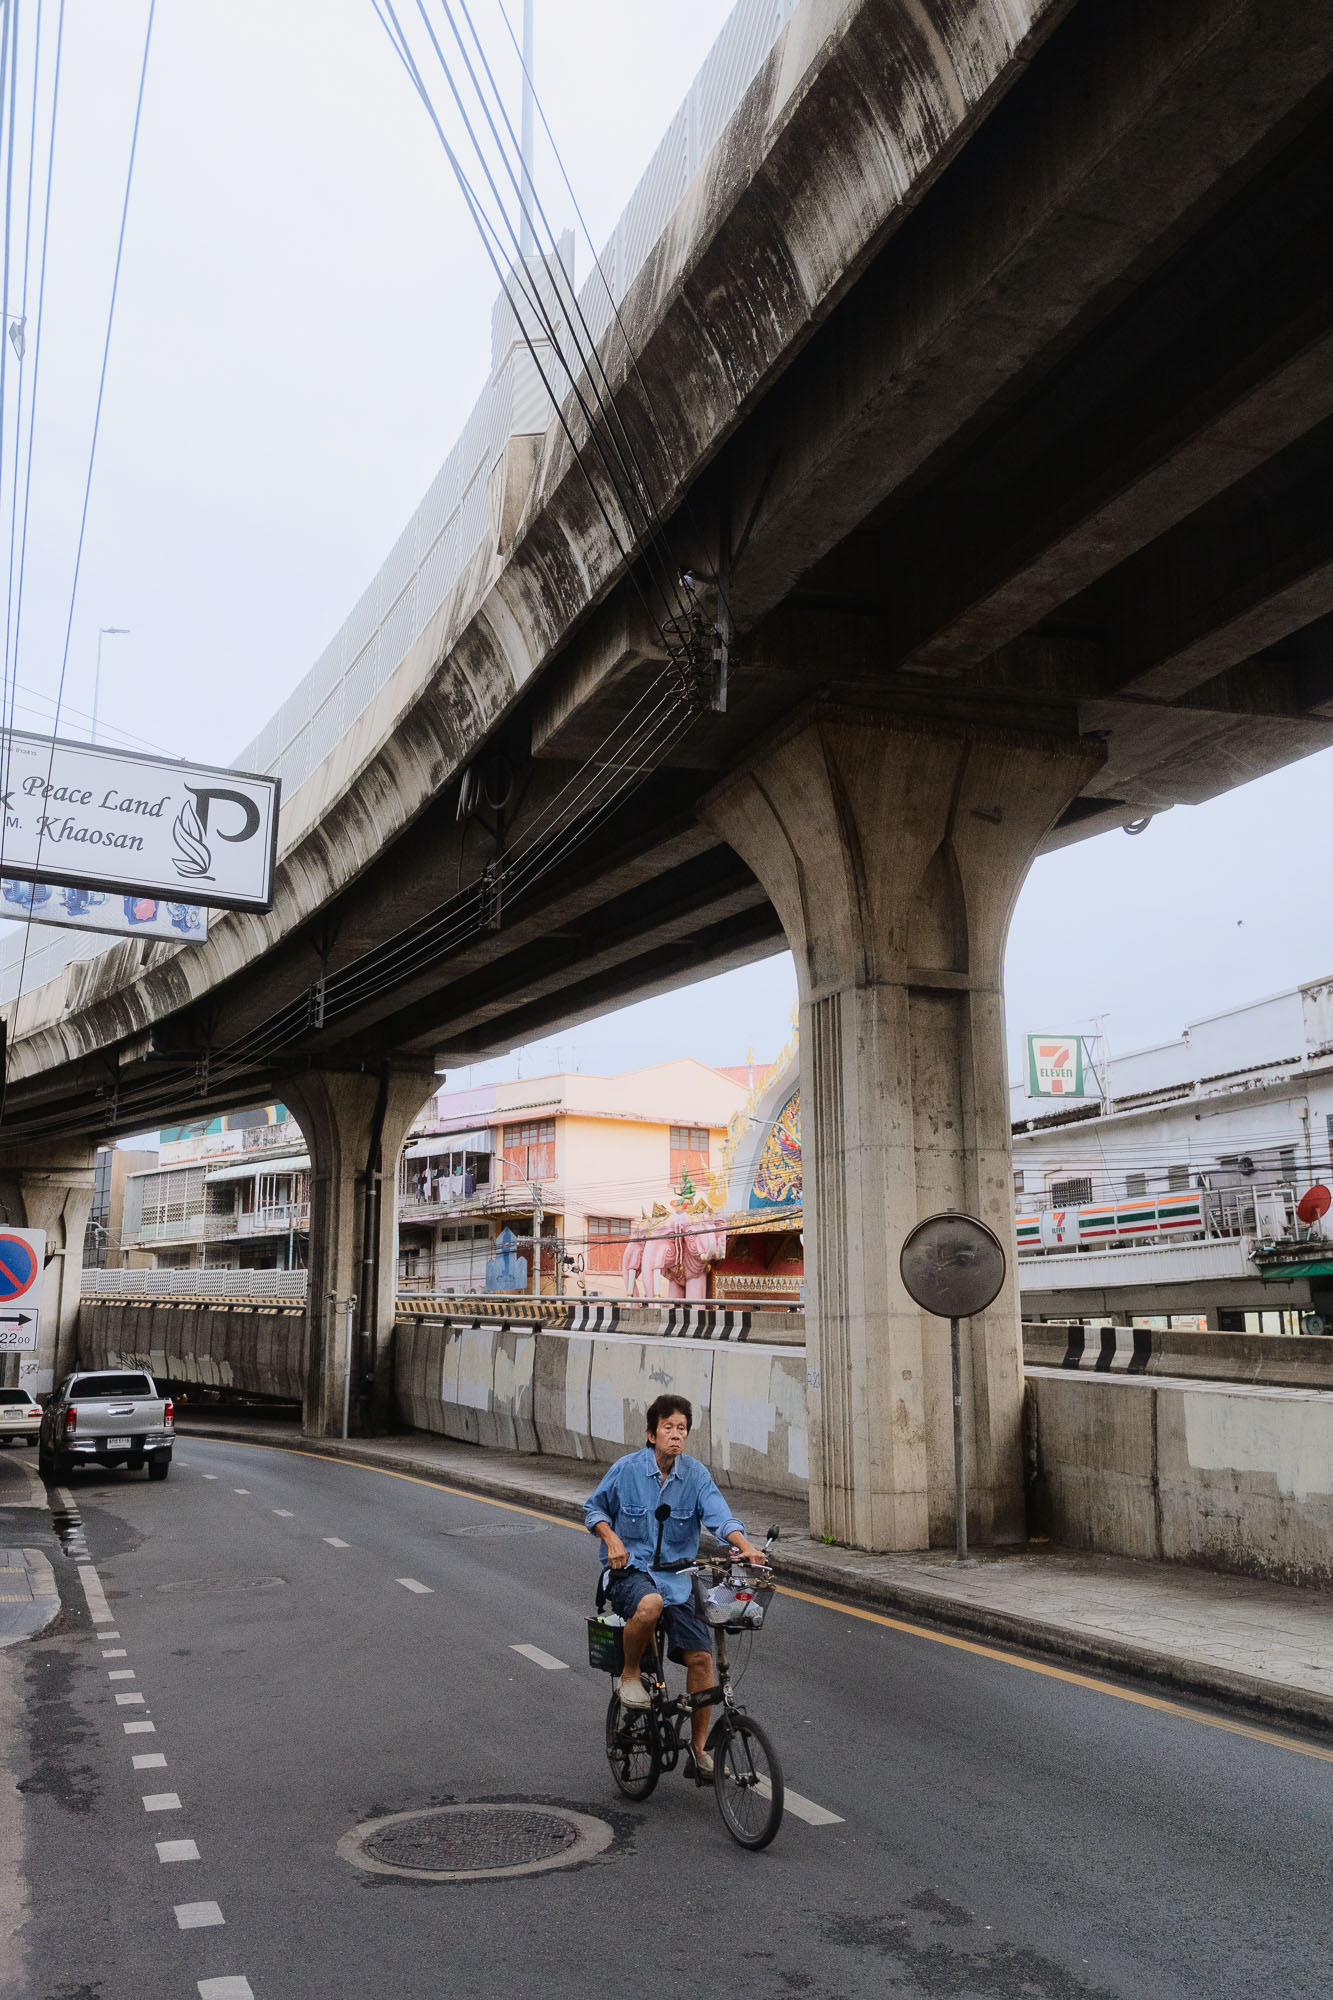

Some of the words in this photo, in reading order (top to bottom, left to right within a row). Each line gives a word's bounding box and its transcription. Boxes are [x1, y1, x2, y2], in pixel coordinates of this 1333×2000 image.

[22, 776, 93, 805] Peace
[98, 790, 171, 818] Land
[36, 815, 144, 851] Khaosan
[1040, 1046, 1070, 1092] 7
[1052, 1212, 1066, 1242] 7
